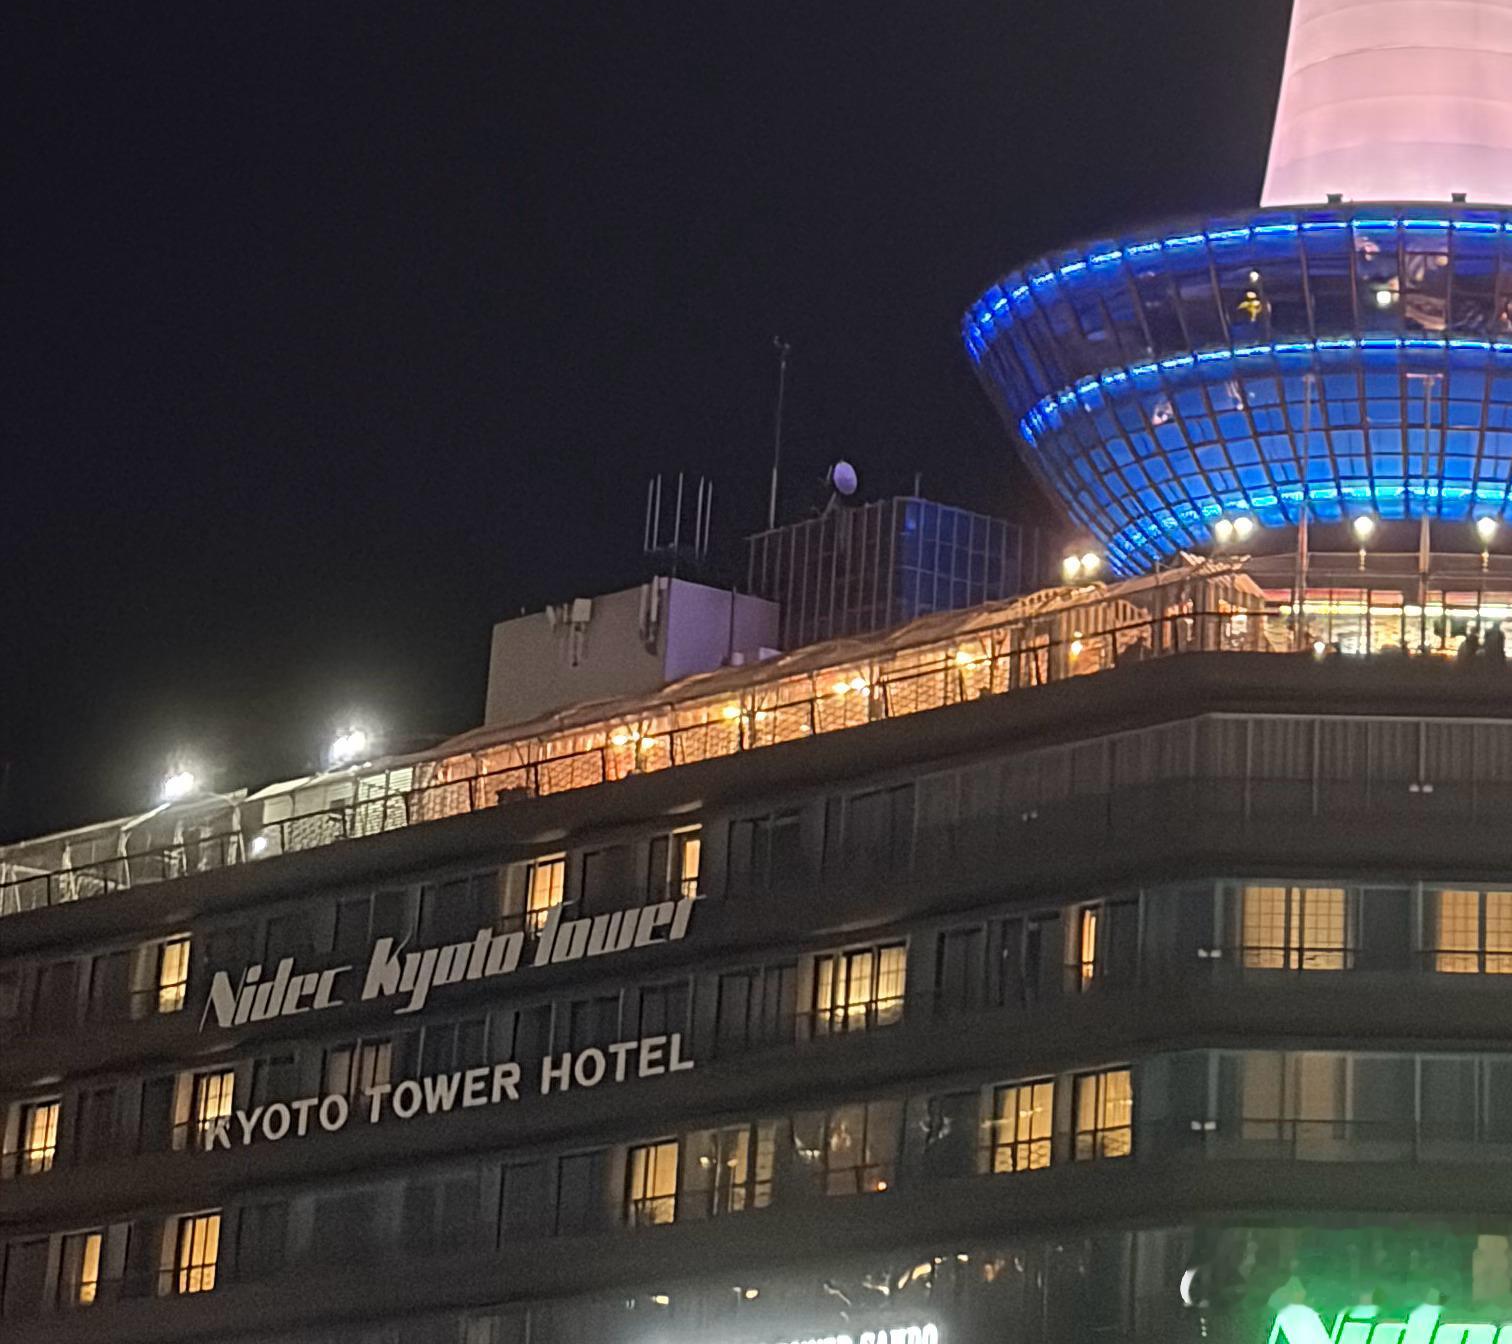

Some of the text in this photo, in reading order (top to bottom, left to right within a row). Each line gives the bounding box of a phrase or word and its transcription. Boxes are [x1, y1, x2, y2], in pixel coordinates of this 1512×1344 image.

[199, 894, 707, 1033] Nidec Kyoto Tower
[205, 1032, 694, 1152] KYOTO TOWER HOTEL
